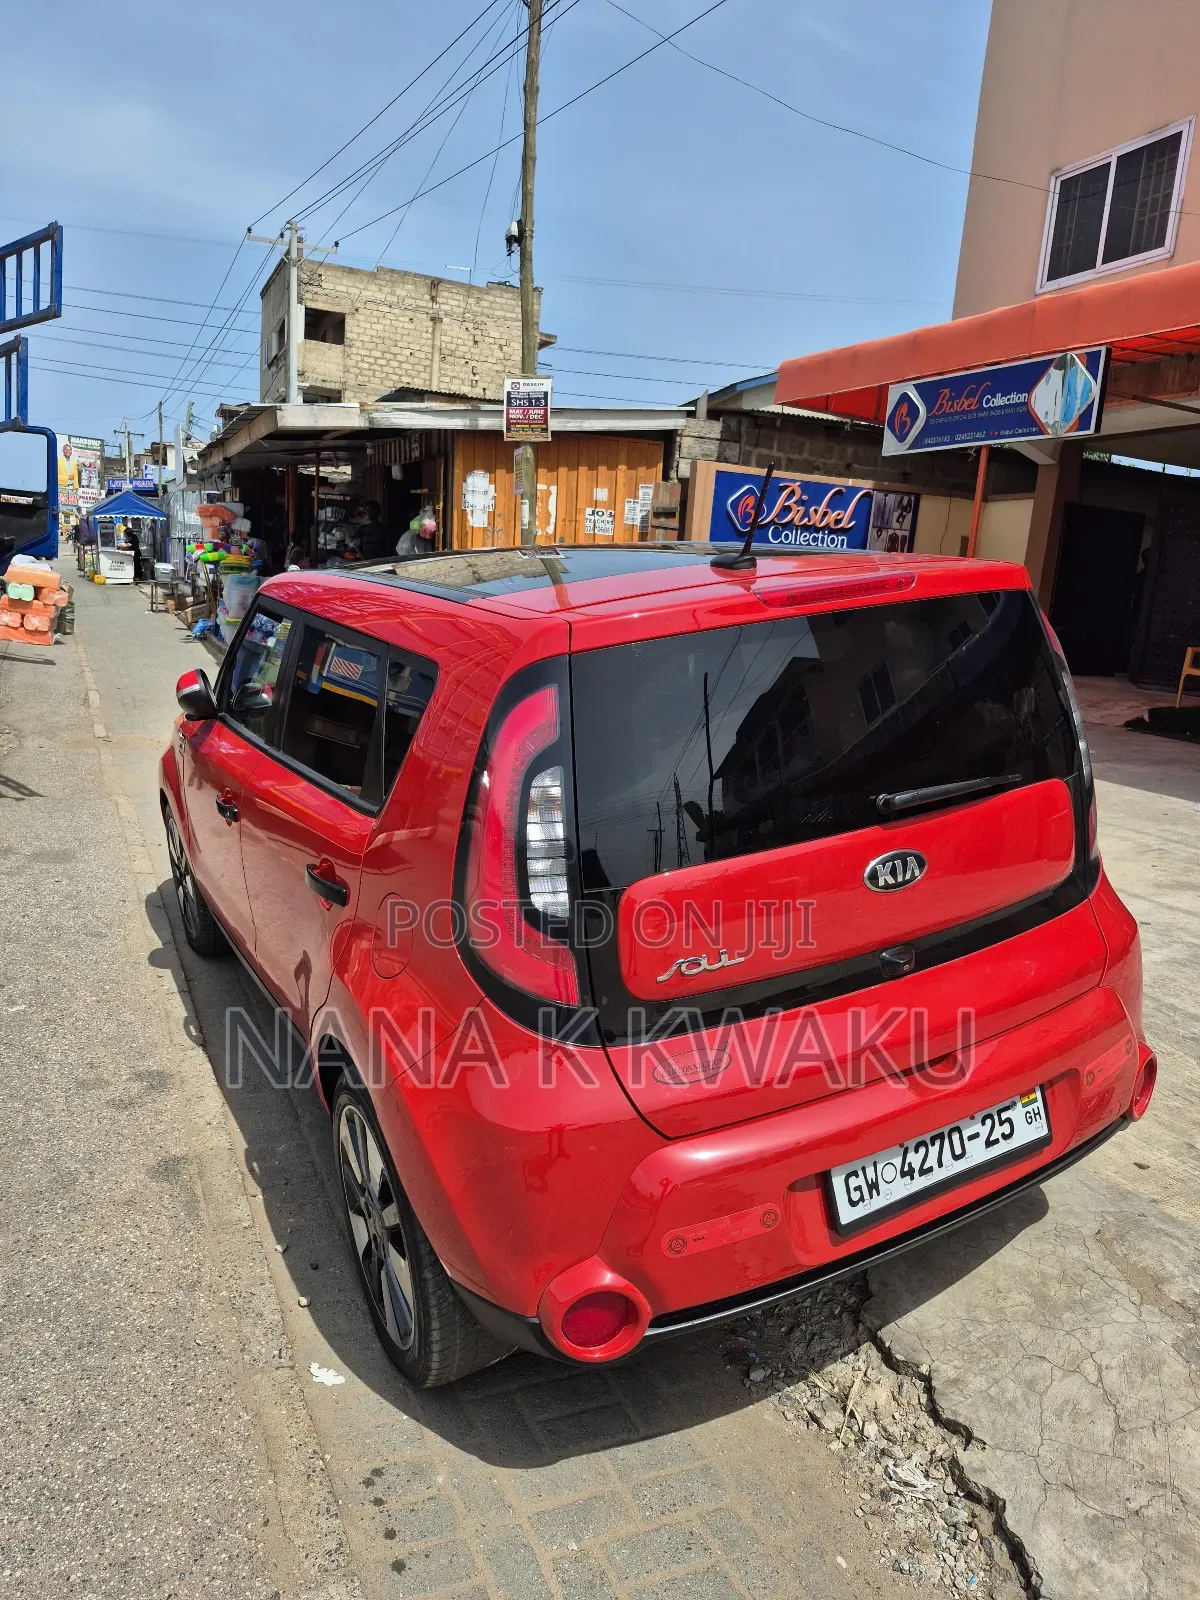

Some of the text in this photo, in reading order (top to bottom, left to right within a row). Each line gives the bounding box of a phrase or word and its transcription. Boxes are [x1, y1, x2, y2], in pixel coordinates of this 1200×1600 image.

[928, 382, 1029, 416] Bisbel Collection
[758, 481, 874, 529] Bisbel
[768, 525, 848, 549] Collection
[876, 856, 920, 887] KIA
[1024, 1106, 1042, 1126] GH
[843, 1104, 1016, 1208] GW 4270-25
